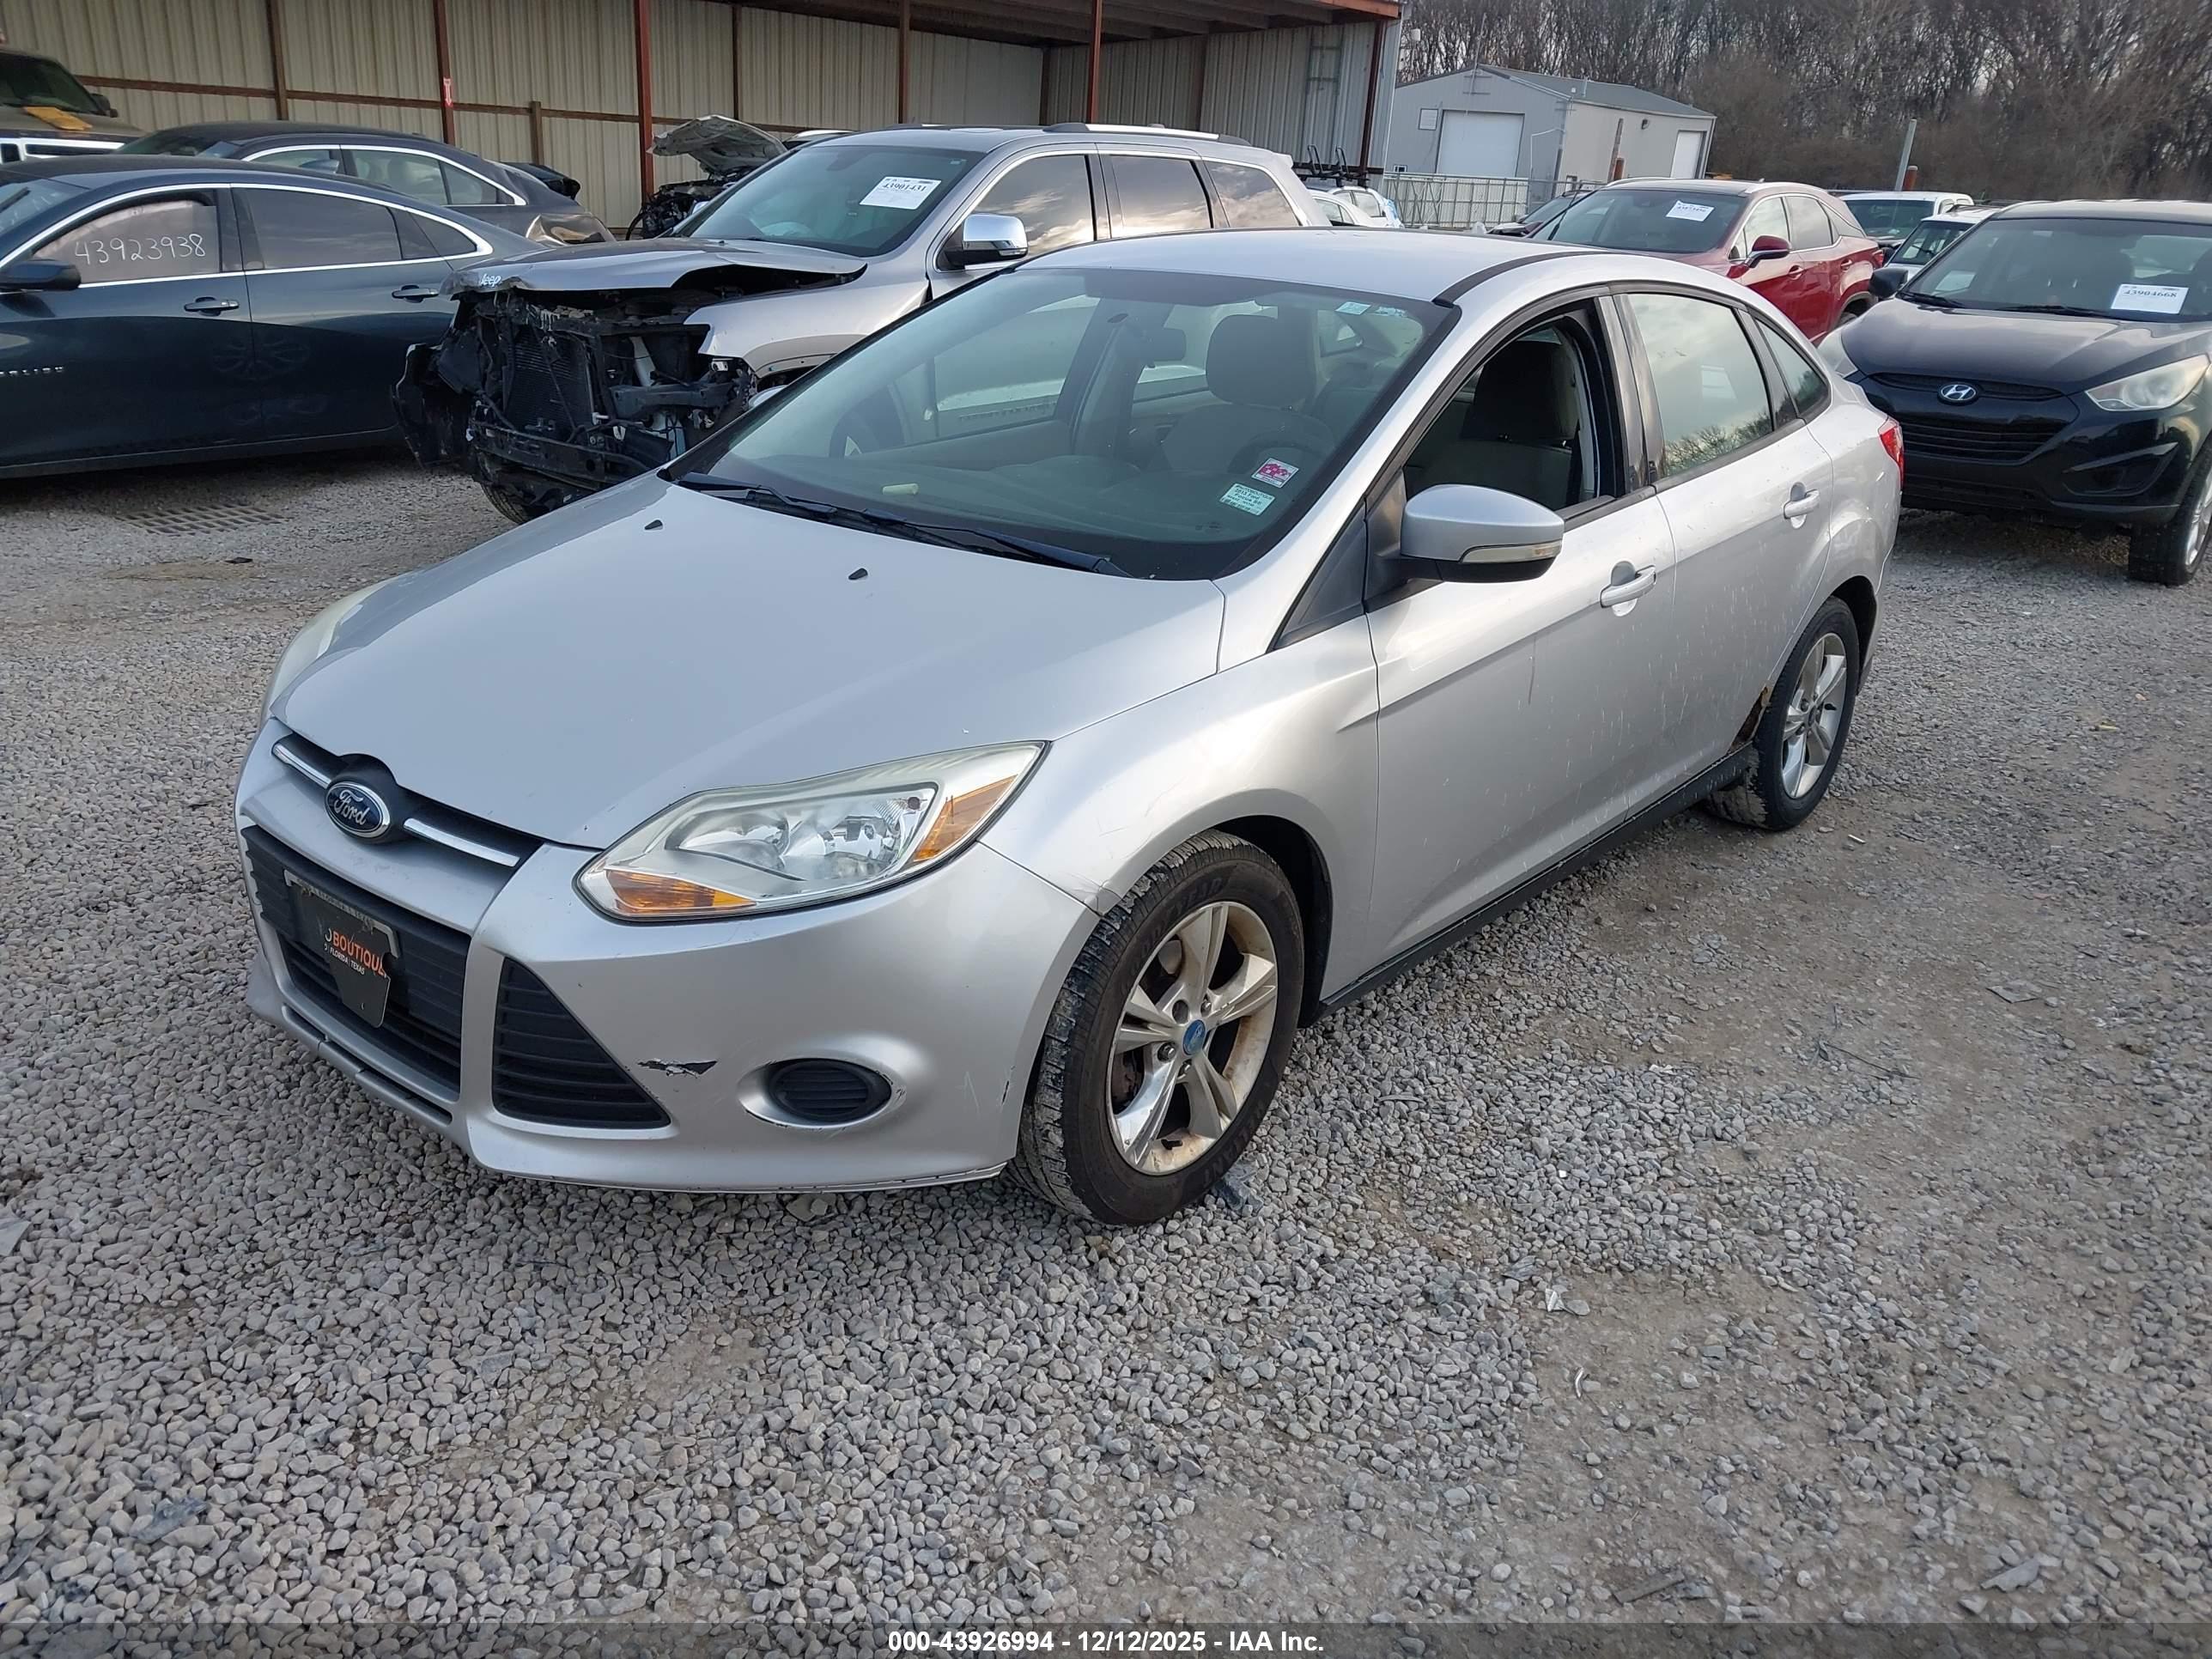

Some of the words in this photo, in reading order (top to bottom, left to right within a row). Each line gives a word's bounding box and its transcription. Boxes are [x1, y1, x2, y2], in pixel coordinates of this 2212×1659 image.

[75, 234, 206, 265] 43923938
[479, 273, 501, 287] Jeep
[333, 789, 370, 825] Ford
[330, 947, 349, 963] FLORIDA
[350, 960, 365, 975] TEXAS
